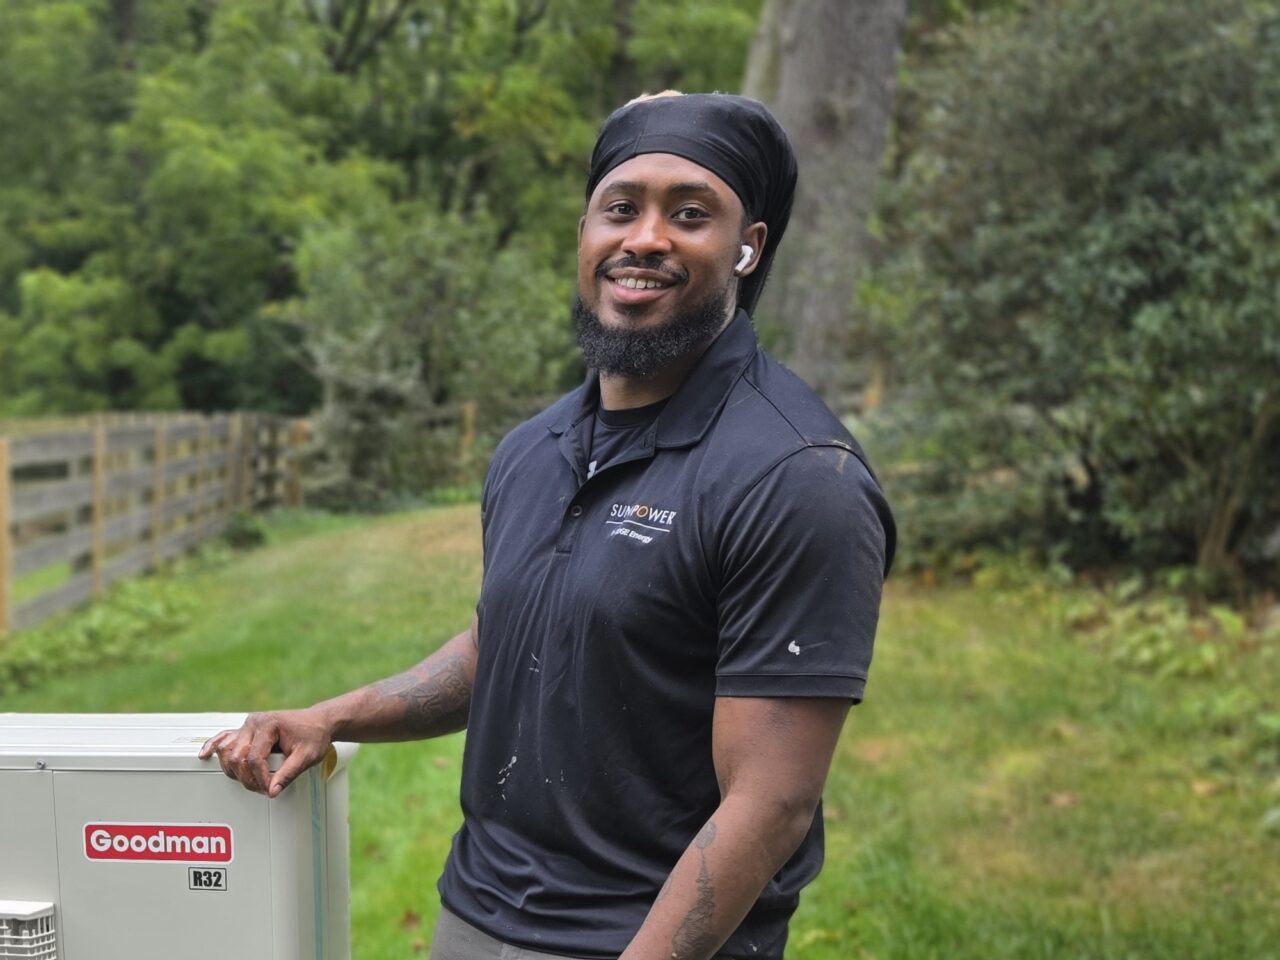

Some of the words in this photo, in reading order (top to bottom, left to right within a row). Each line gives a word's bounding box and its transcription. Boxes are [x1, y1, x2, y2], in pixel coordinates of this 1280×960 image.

[611, 504, 677, 524] SUNPOWER
[90, 829, 226, 854] Goodman
[193, 871, 222, 887] R32
